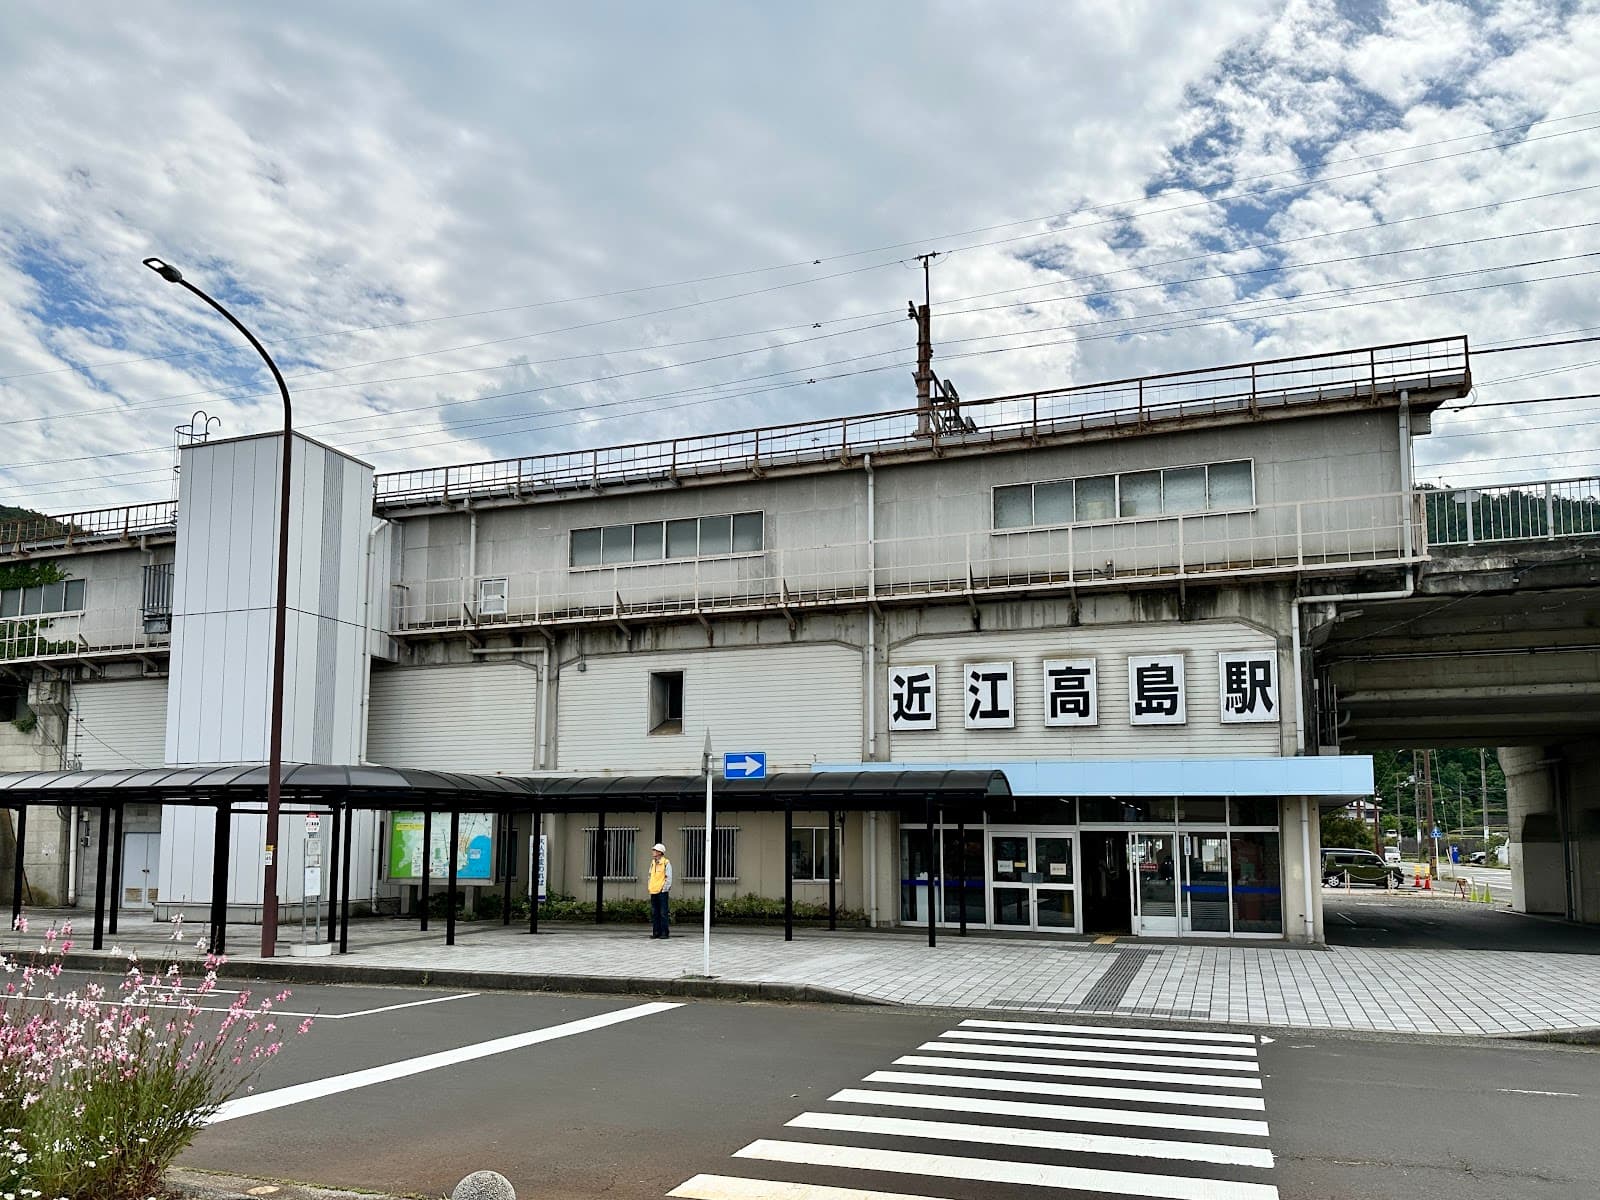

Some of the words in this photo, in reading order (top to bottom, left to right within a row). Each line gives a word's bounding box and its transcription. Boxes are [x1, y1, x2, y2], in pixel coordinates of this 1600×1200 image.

[892, 660, 1274, 722] 近江高島駅
